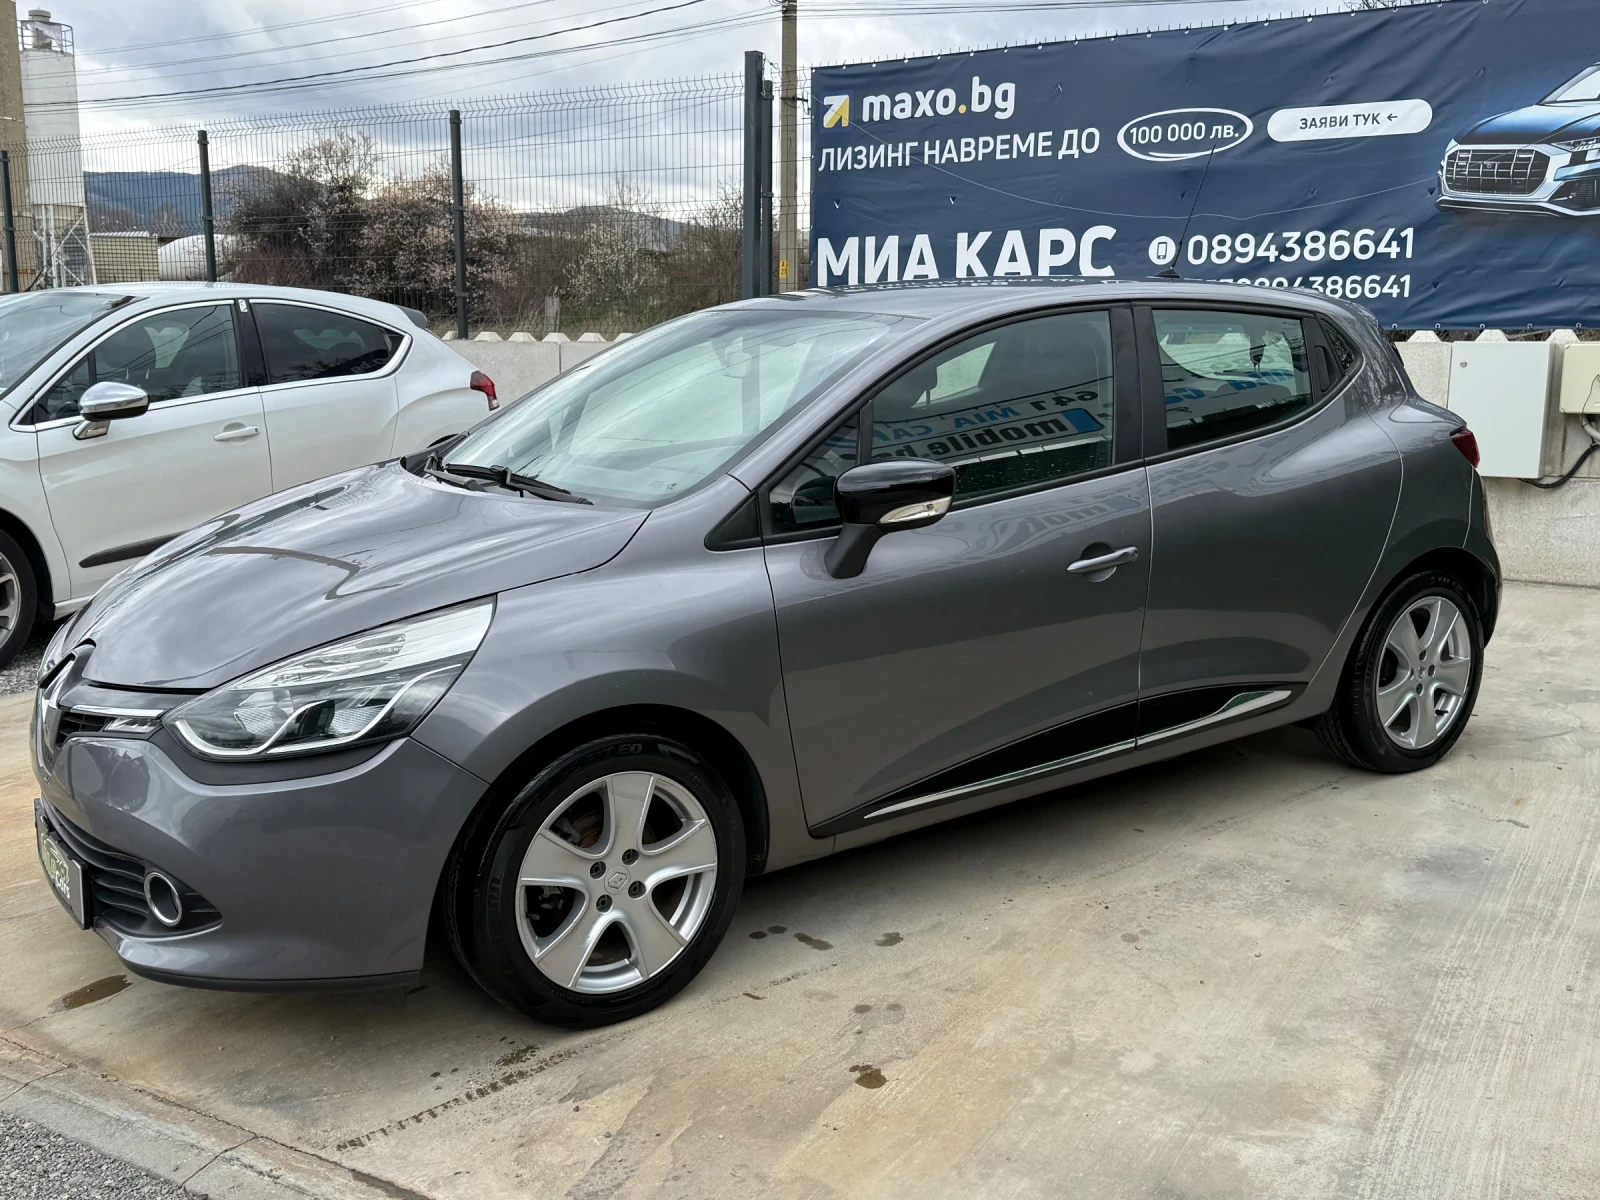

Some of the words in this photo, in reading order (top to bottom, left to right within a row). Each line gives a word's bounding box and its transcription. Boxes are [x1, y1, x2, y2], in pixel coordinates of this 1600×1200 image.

[862, 76, 1016, 122] maxo.bg
[1299, 114, 1349, 131] ЗАЯВИ
[1352, 113, 1381, 127] ТУК
[818, 141, 919, 172] ЛИЗИНГ
[923, 131, 1054, 166] НАВРЕМЕ
[1057, 127, 1100, 160] ДО
[1129, 124, 1162, 144] 100
[1167, 122, 1206, 142] 000
[1209, 124, 1240, 140] лв.
[817, 233, 940, 287] МИА
[955, 225, 1117, 279] КАРС
[1187, 227, 1415, 265] 0894386641
